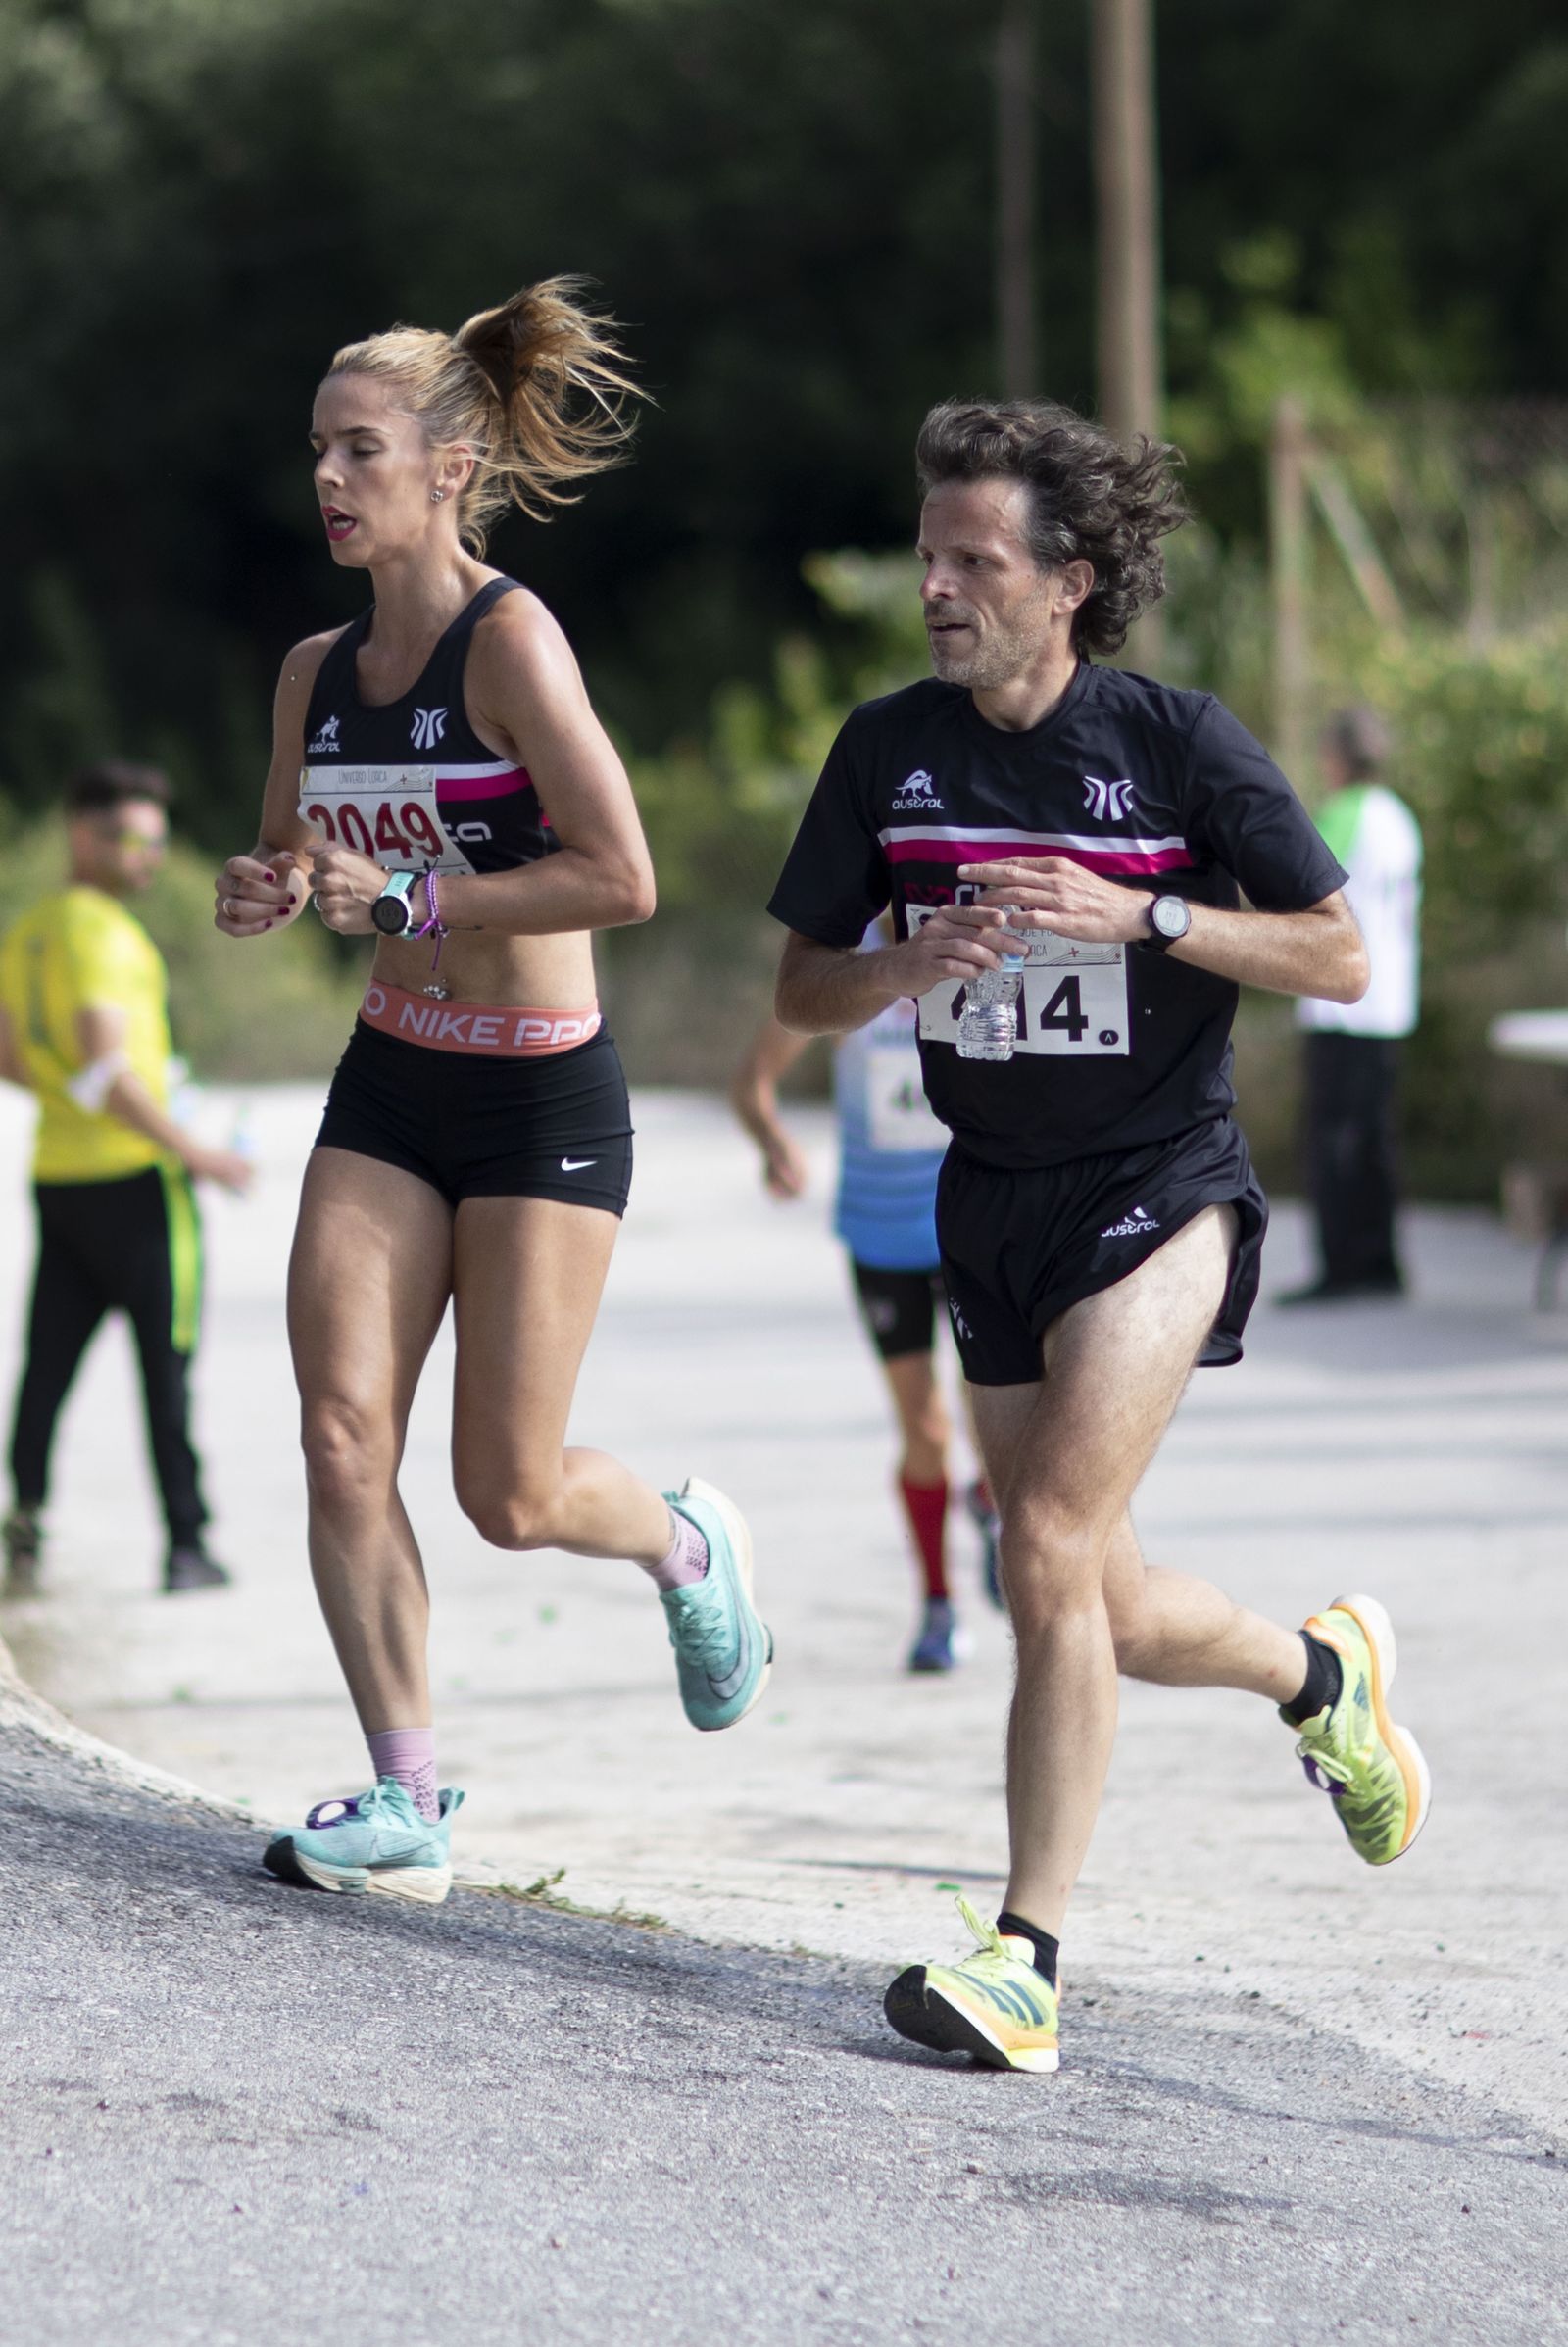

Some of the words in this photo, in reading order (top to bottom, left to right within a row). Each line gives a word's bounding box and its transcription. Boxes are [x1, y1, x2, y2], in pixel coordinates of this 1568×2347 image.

[892, 799, 945, 810] austral
[307, 802, 444, 859] 2049
[398, 1002, 505, 1046] NIKE
